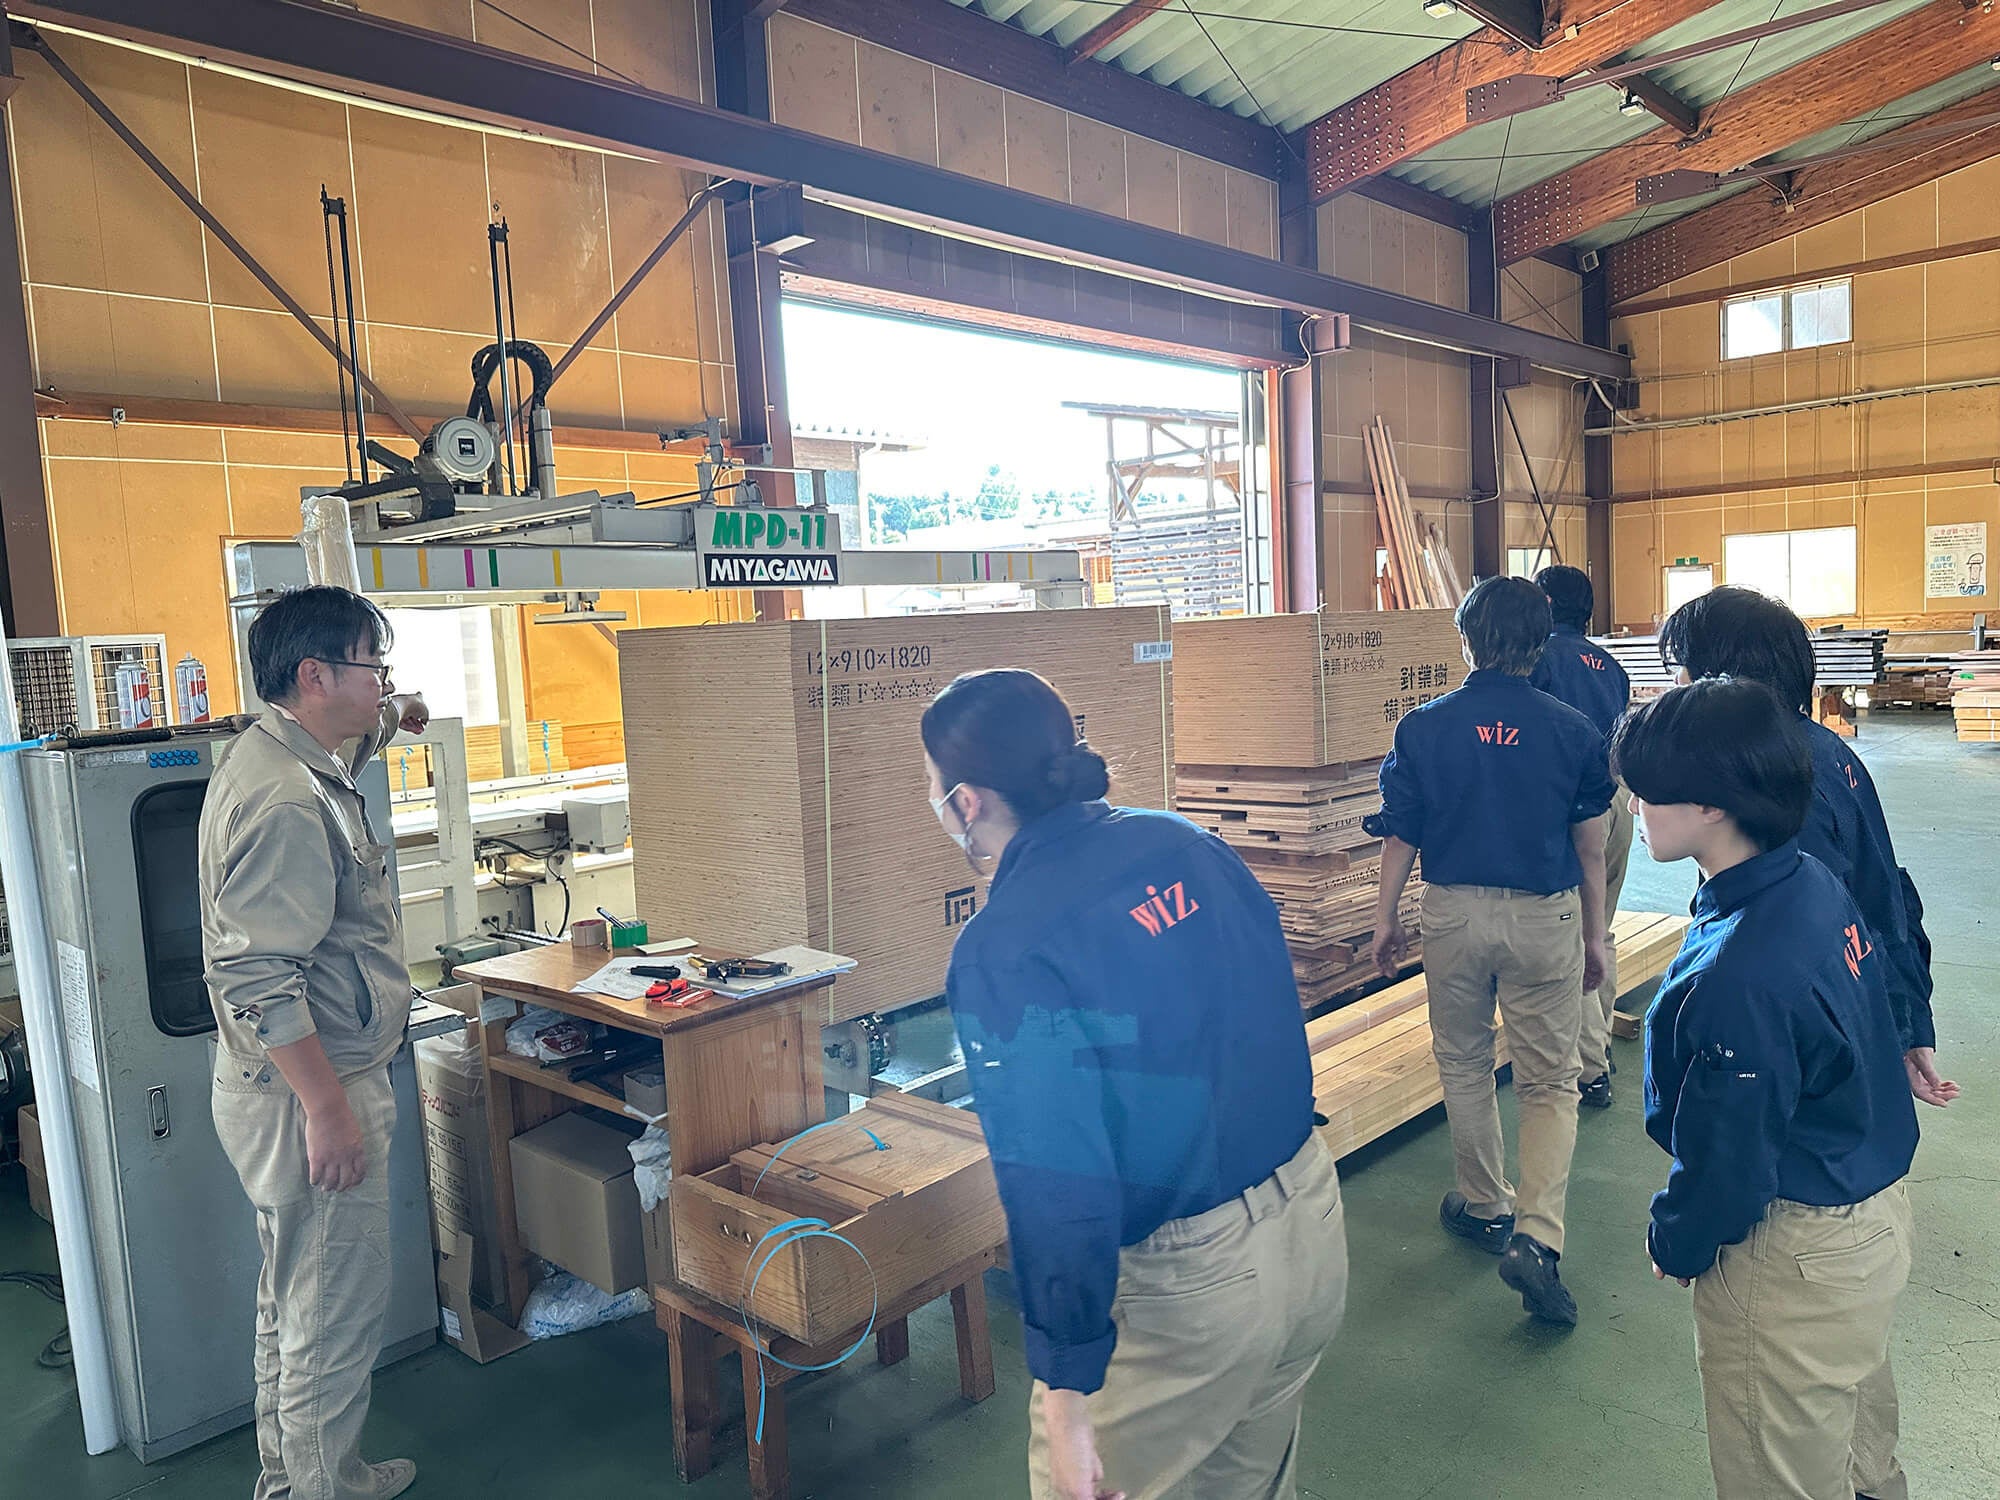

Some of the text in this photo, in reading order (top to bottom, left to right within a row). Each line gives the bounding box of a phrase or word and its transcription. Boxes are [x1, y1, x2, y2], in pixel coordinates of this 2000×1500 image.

[712, 511, 827, 550] MPD-11
[710, 558, 834, 582] MIYAGAWA
[1383, 692, 1446, 723] 構造用
[1475, 721, 1520, 746] wiz
[1129, 881, 1200, 937] wiz
